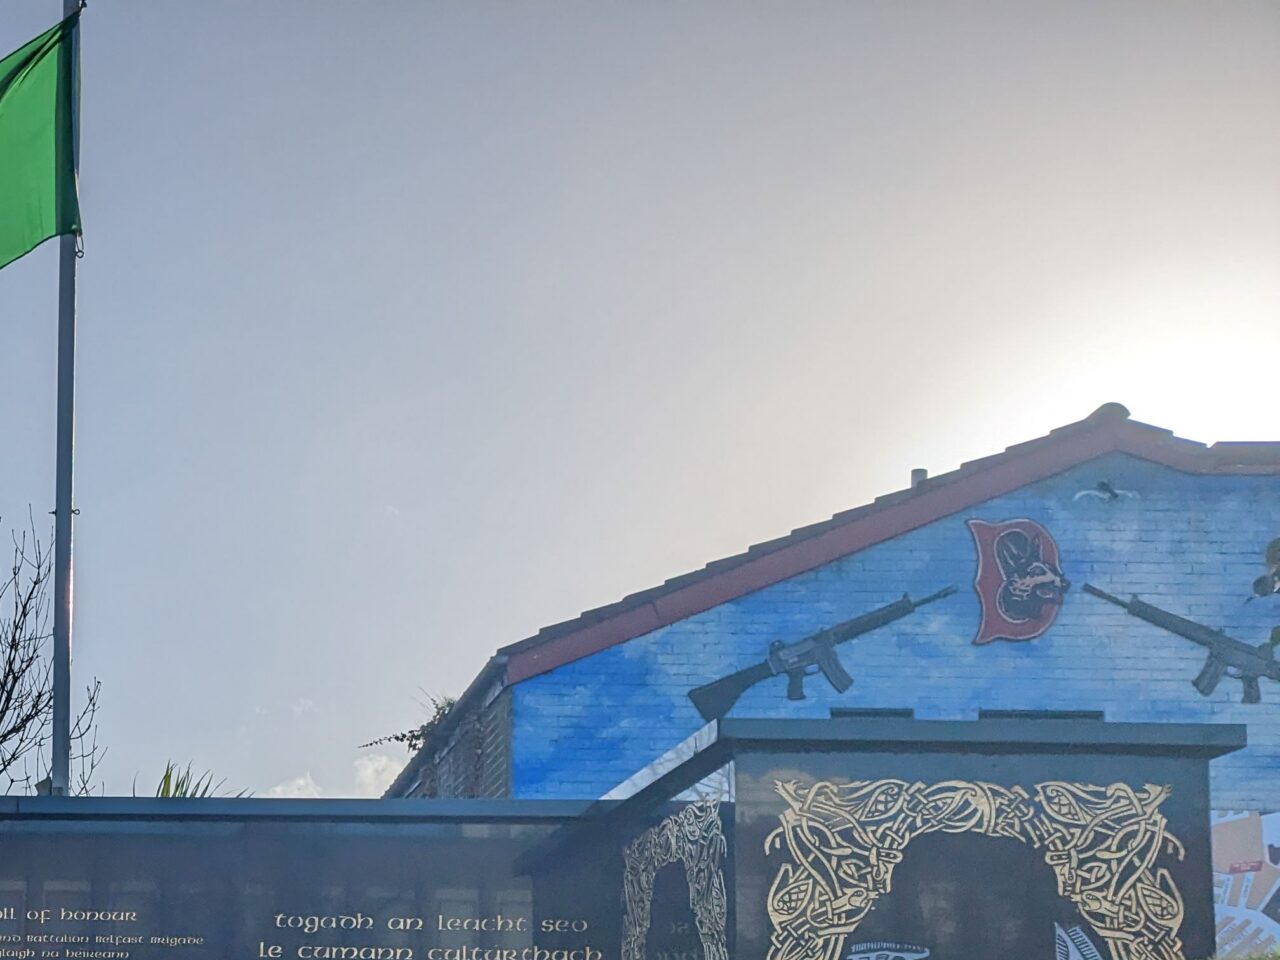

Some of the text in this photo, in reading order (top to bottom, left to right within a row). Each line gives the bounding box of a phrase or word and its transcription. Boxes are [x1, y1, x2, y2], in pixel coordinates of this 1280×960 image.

[27, 909, 51, 925] of
[60, 908, 137, 922] honour
[274, 913, 588, 932] togadh an leacht seo
[27, 934, 89, 945] battalion
[95, 934, 144, 946] belfast
[150, 935, 204, 947] brigade
[259, 942, 282, 958] le
[298, 945, 412, 960] cumann
